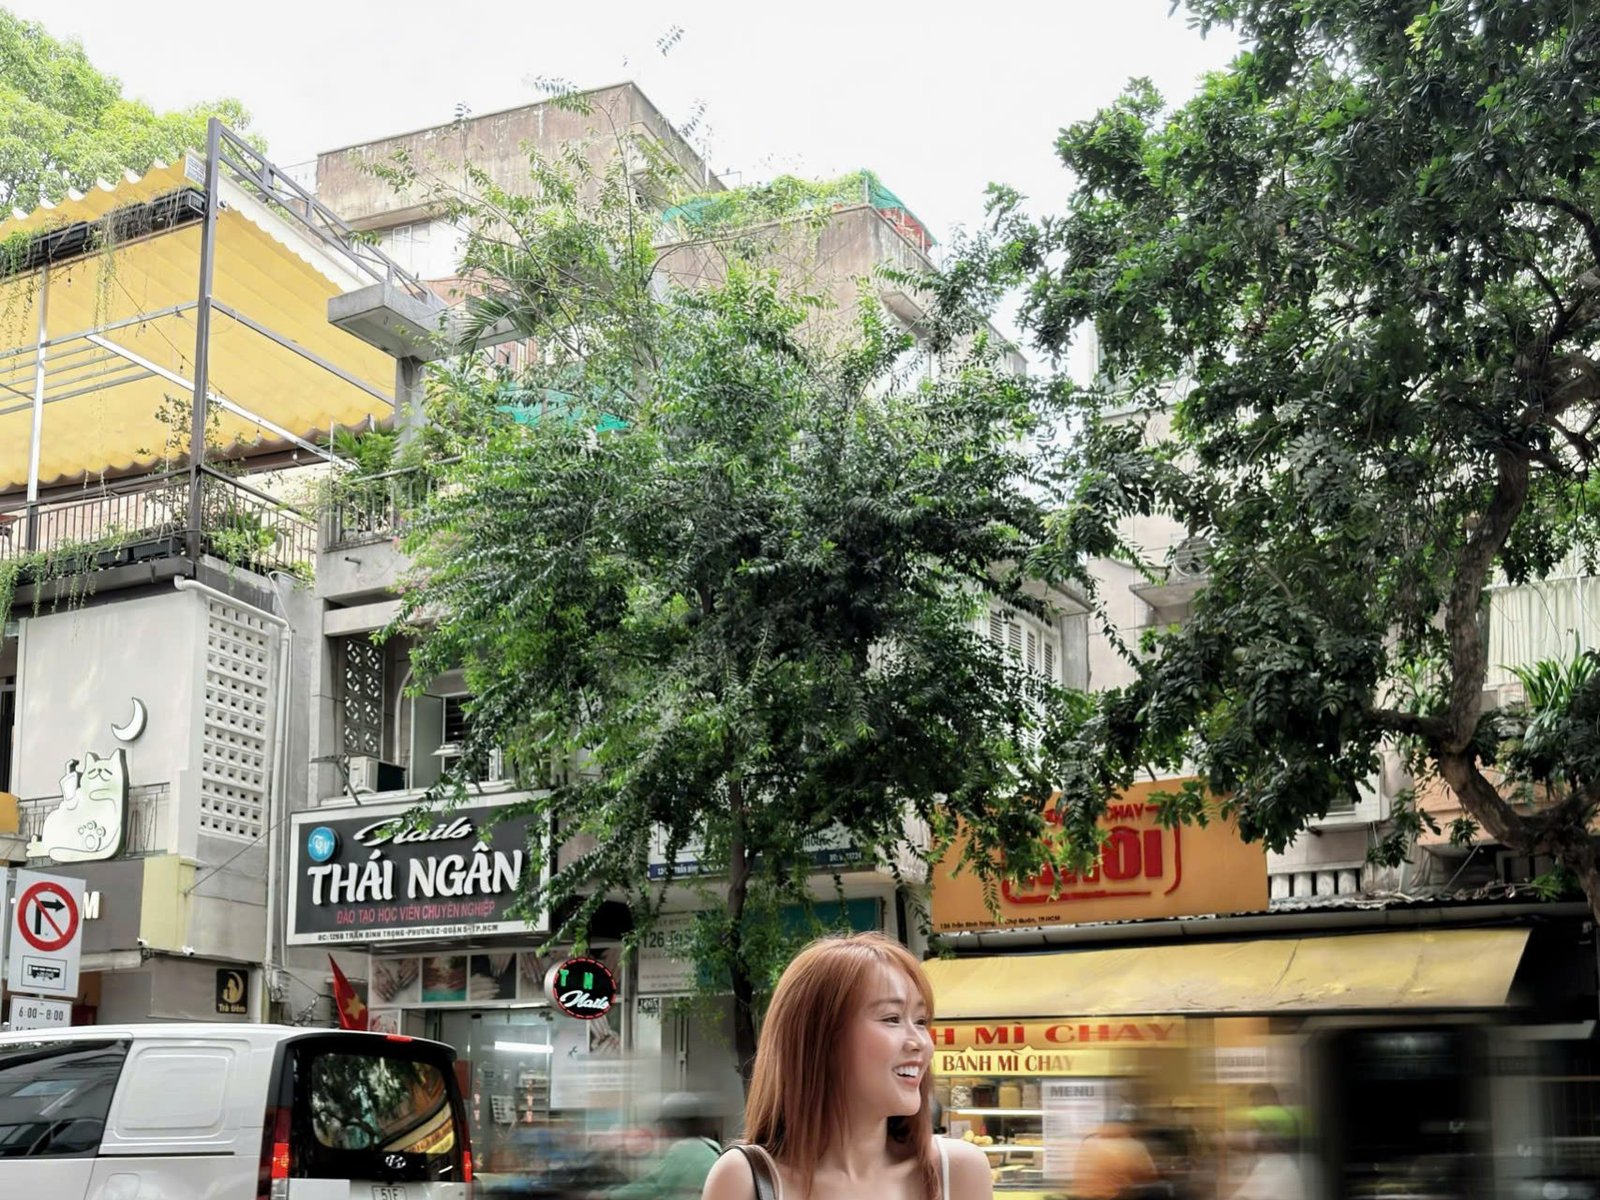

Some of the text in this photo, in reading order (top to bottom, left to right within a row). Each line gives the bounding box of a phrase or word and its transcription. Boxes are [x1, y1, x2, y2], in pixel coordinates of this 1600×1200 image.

[307, 841, 523, 905] THÁI NGÂN
[378, 906, 398, 924] HỌC
[559, 990, 610, 1010] Nails
[975, 1021, 1026, 1045] MÌ
[1044, 1023, 1175, 1043] CHAY
[943, 1050, 1073, 1072] BÁNH MÌ CHAY
[1050, 1085, 1095, 1098] MENU
